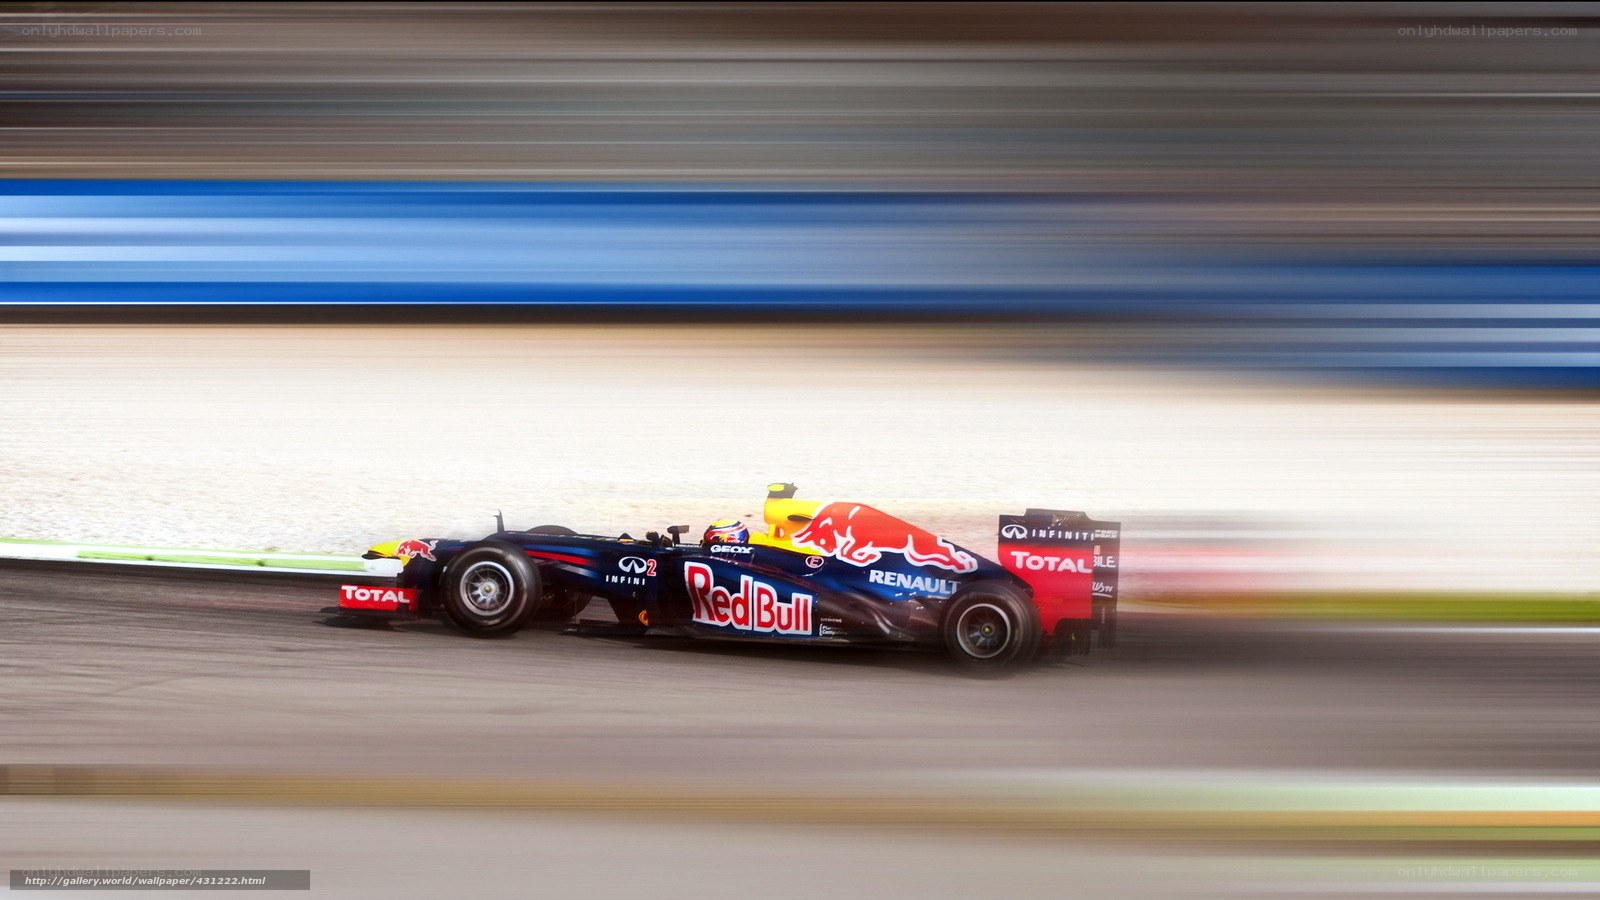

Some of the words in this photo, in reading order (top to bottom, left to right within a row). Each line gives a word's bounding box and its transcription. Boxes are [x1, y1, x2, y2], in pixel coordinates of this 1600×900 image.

[1032, 529, 1094, 540] INFINITI
[710, 544, 754, 553] GEOX
[646, 559, 657, 576] 2
[1010, 551, 1092, 573] TOTAL
[869, 569, 962, 594] RENAULT
[341, 585, 411, 603] TOTAL
[684, 561, 753, 631] Red
[753, 581, 812, 635] Bull
